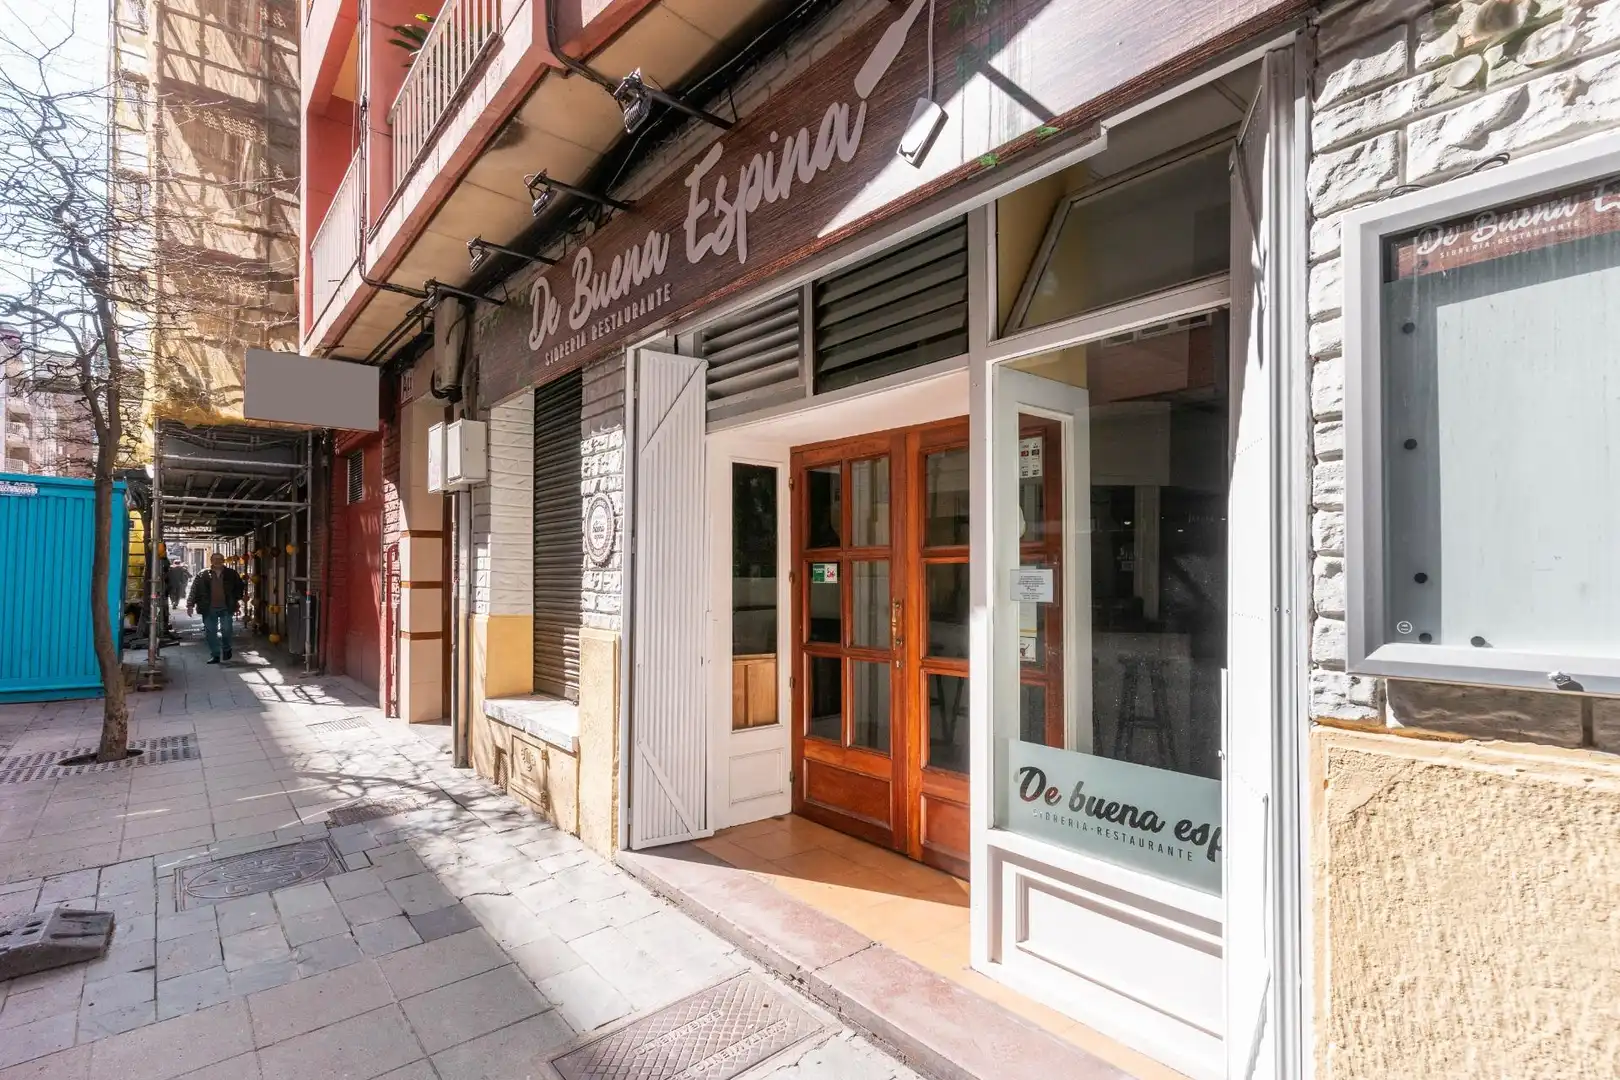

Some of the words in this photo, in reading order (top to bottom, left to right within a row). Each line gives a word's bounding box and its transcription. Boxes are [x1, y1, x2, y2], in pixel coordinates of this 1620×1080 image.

[529, 276, 562, 351] De
[568, 230, 670, 330] Buena
[683, 100, 867, 264] Espina
[591, 283, 671, 341] RESTAURANTE
[1013, 766, 1062, 806] De
[1068, 781, 1166, 833] buena
